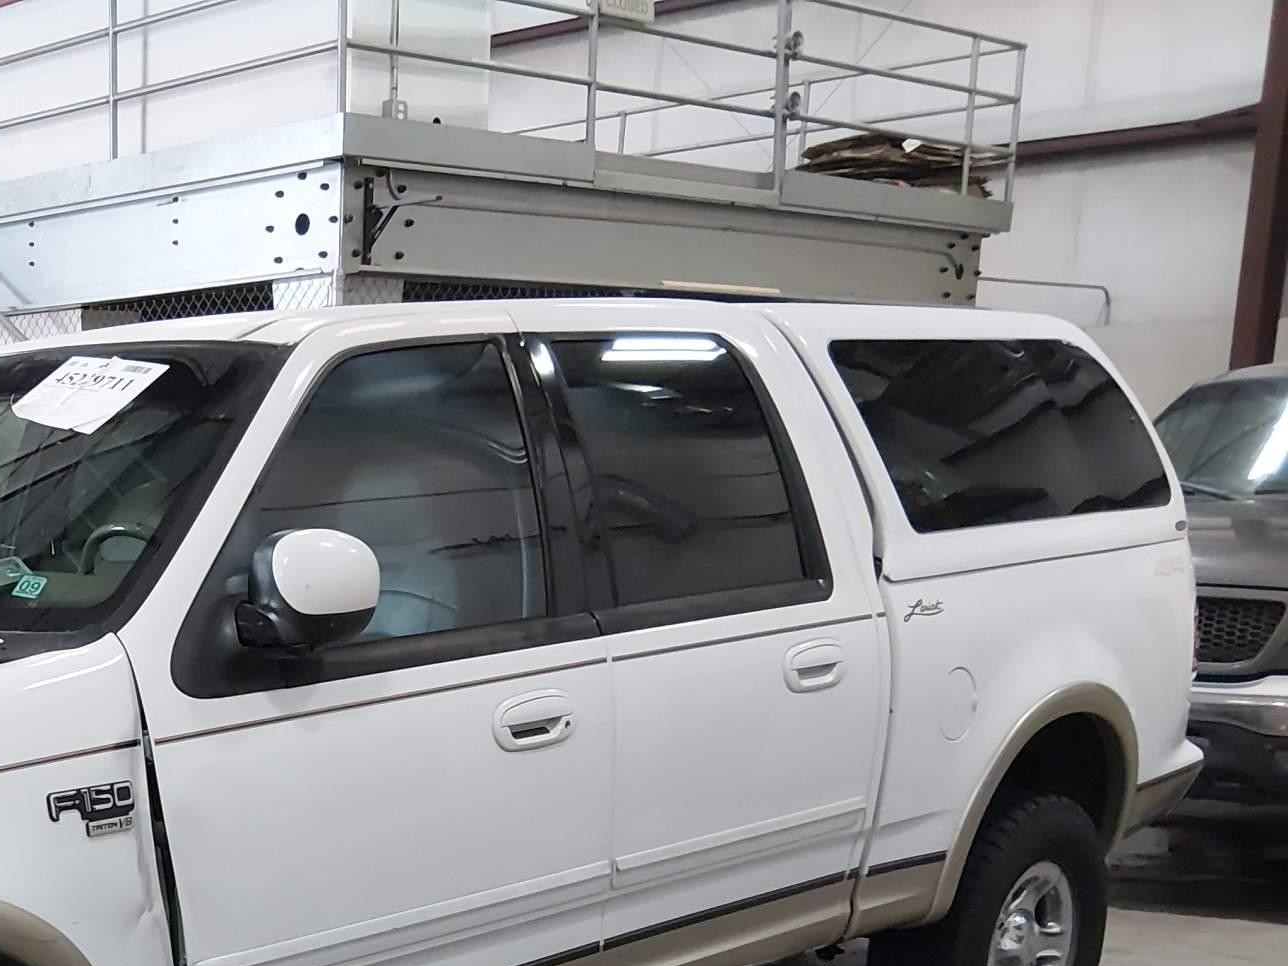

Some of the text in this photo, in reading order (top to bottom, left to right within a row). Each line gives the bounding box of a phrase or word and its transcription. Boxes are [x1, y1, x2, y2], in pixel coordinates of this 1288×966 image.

[56, 371, 135, 392] 4529711
[19, 580, 41, 593] 09
[118, 816, 133, 829] V8
